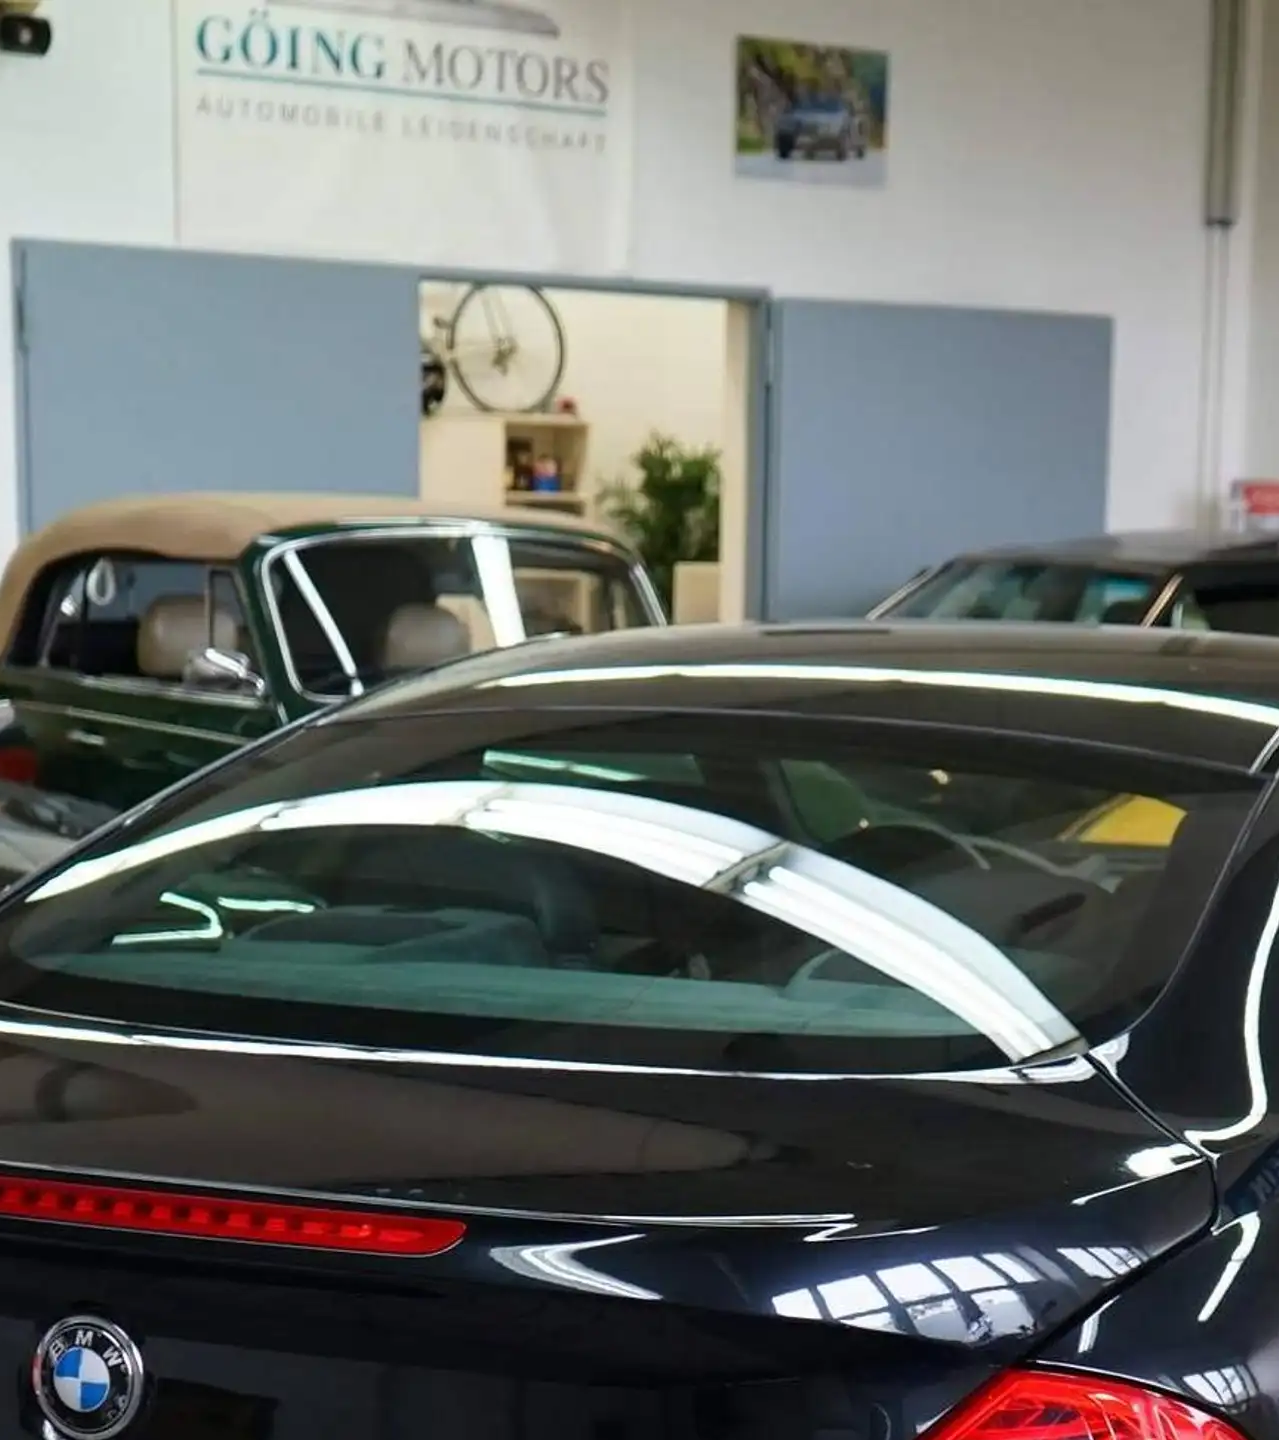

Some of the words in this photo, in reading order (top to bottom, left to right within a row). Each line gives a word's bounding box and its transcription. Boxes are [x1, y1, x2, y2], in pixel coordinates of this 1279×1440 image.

[196, 10, 386, 79] GÖING
[402, 39, 610, 105] MOTORS
[196, 93, 385, 134] AUTOMOBILE
[402, 117, 607, 153] LEIDENSCHAFT
[49, 1330, 122, 1365] BMW
